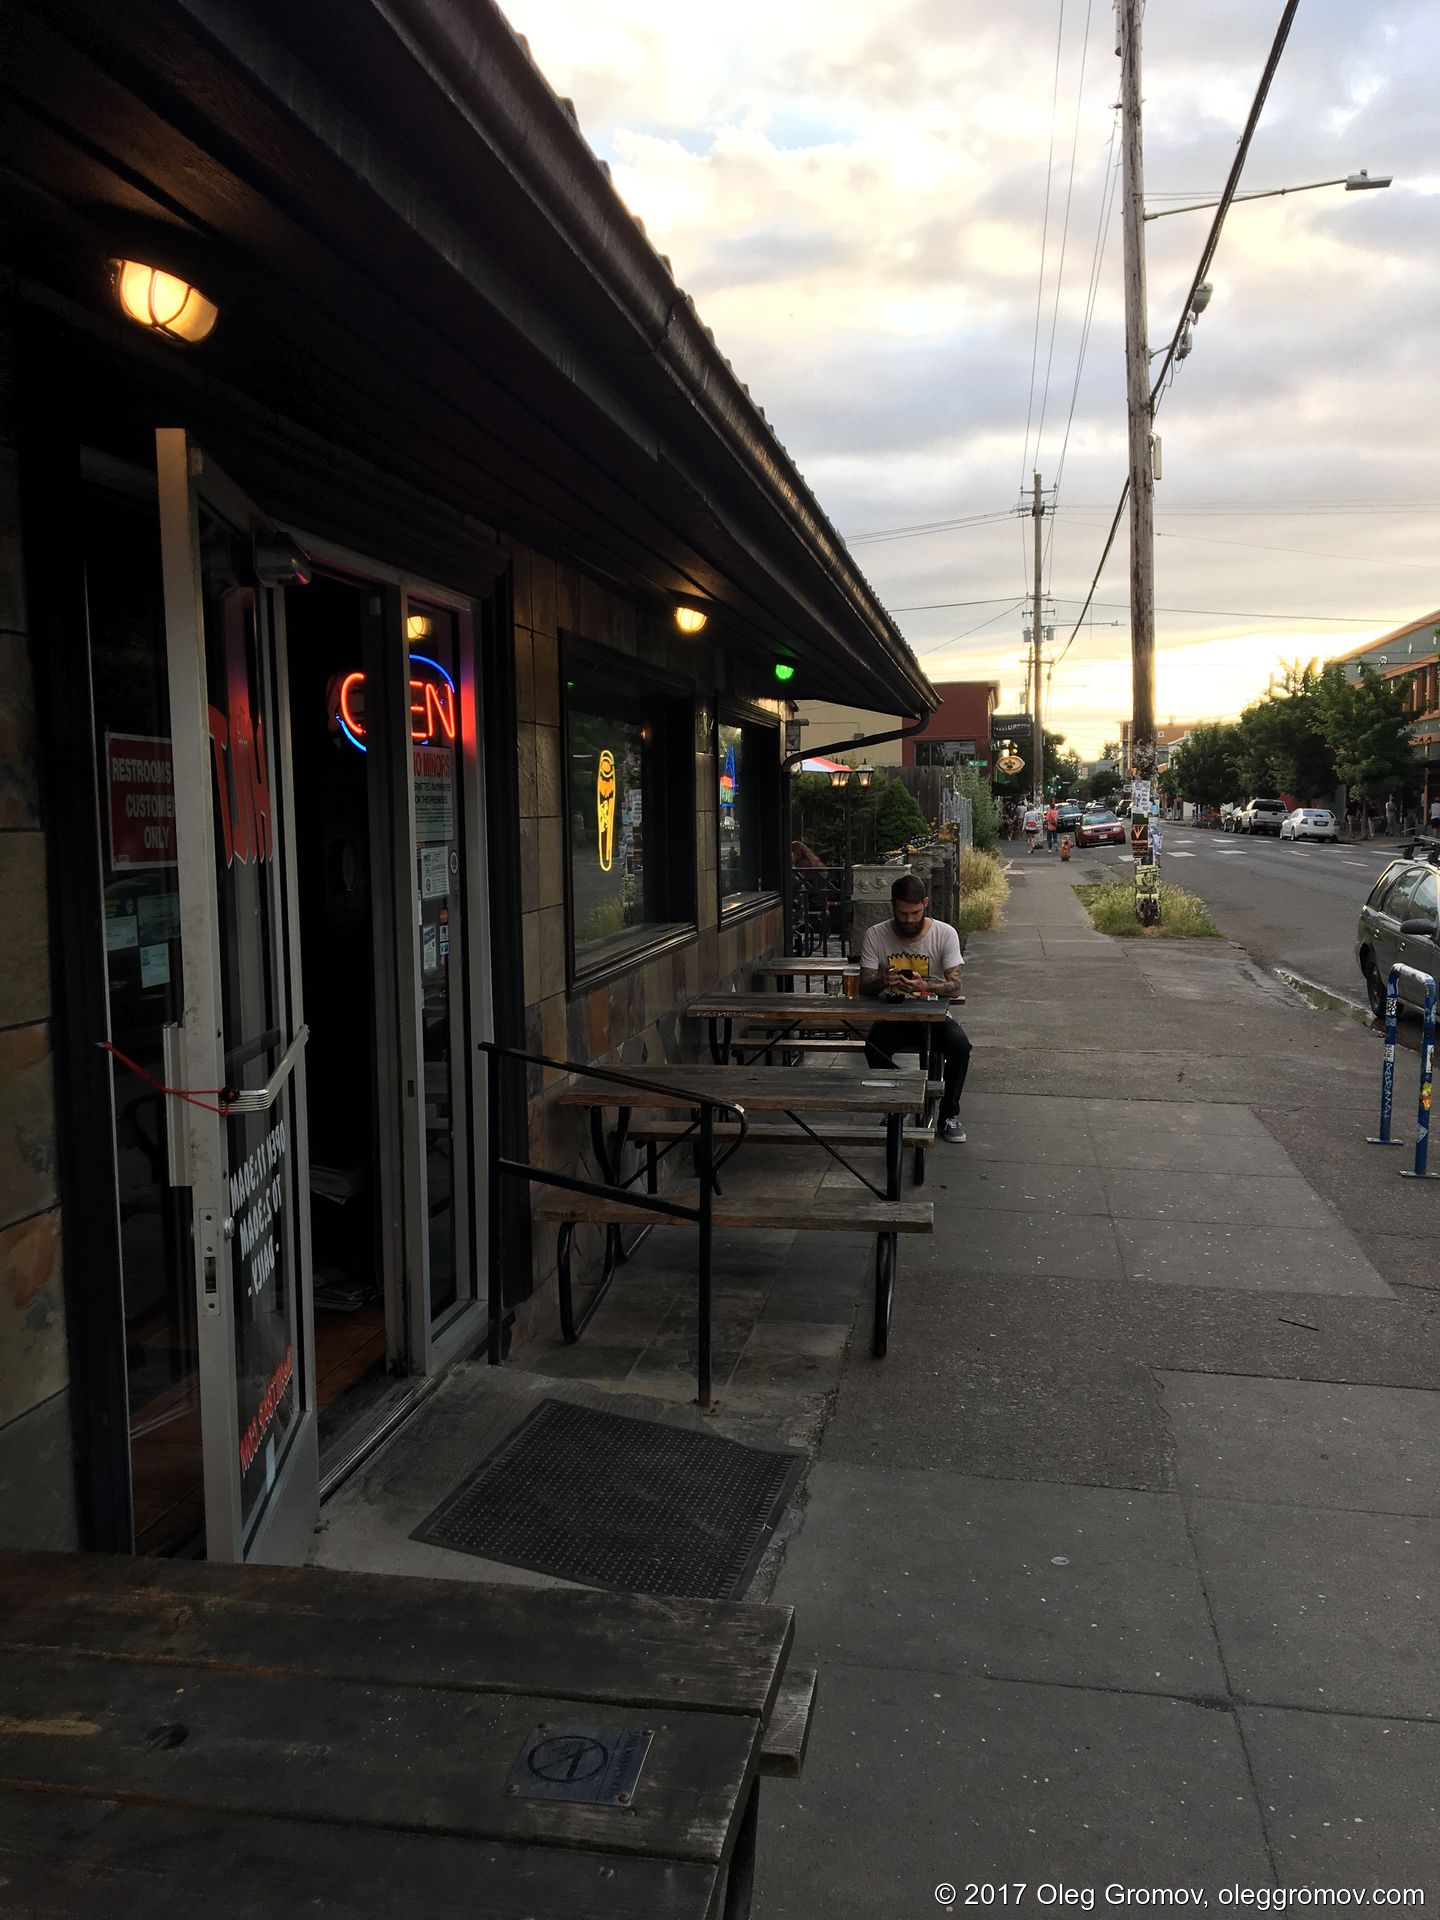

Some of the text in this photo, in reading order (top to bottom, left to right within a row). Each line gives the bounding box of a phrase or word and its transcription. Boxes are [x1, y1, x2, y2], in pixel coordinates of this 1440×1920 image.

[341, 672, 456, 738] OEN
[112, 757, 172, 784] RESTROOMS
[423, 752, 450, 778] MINORS
[144, 824, 170, 849] ONLY
